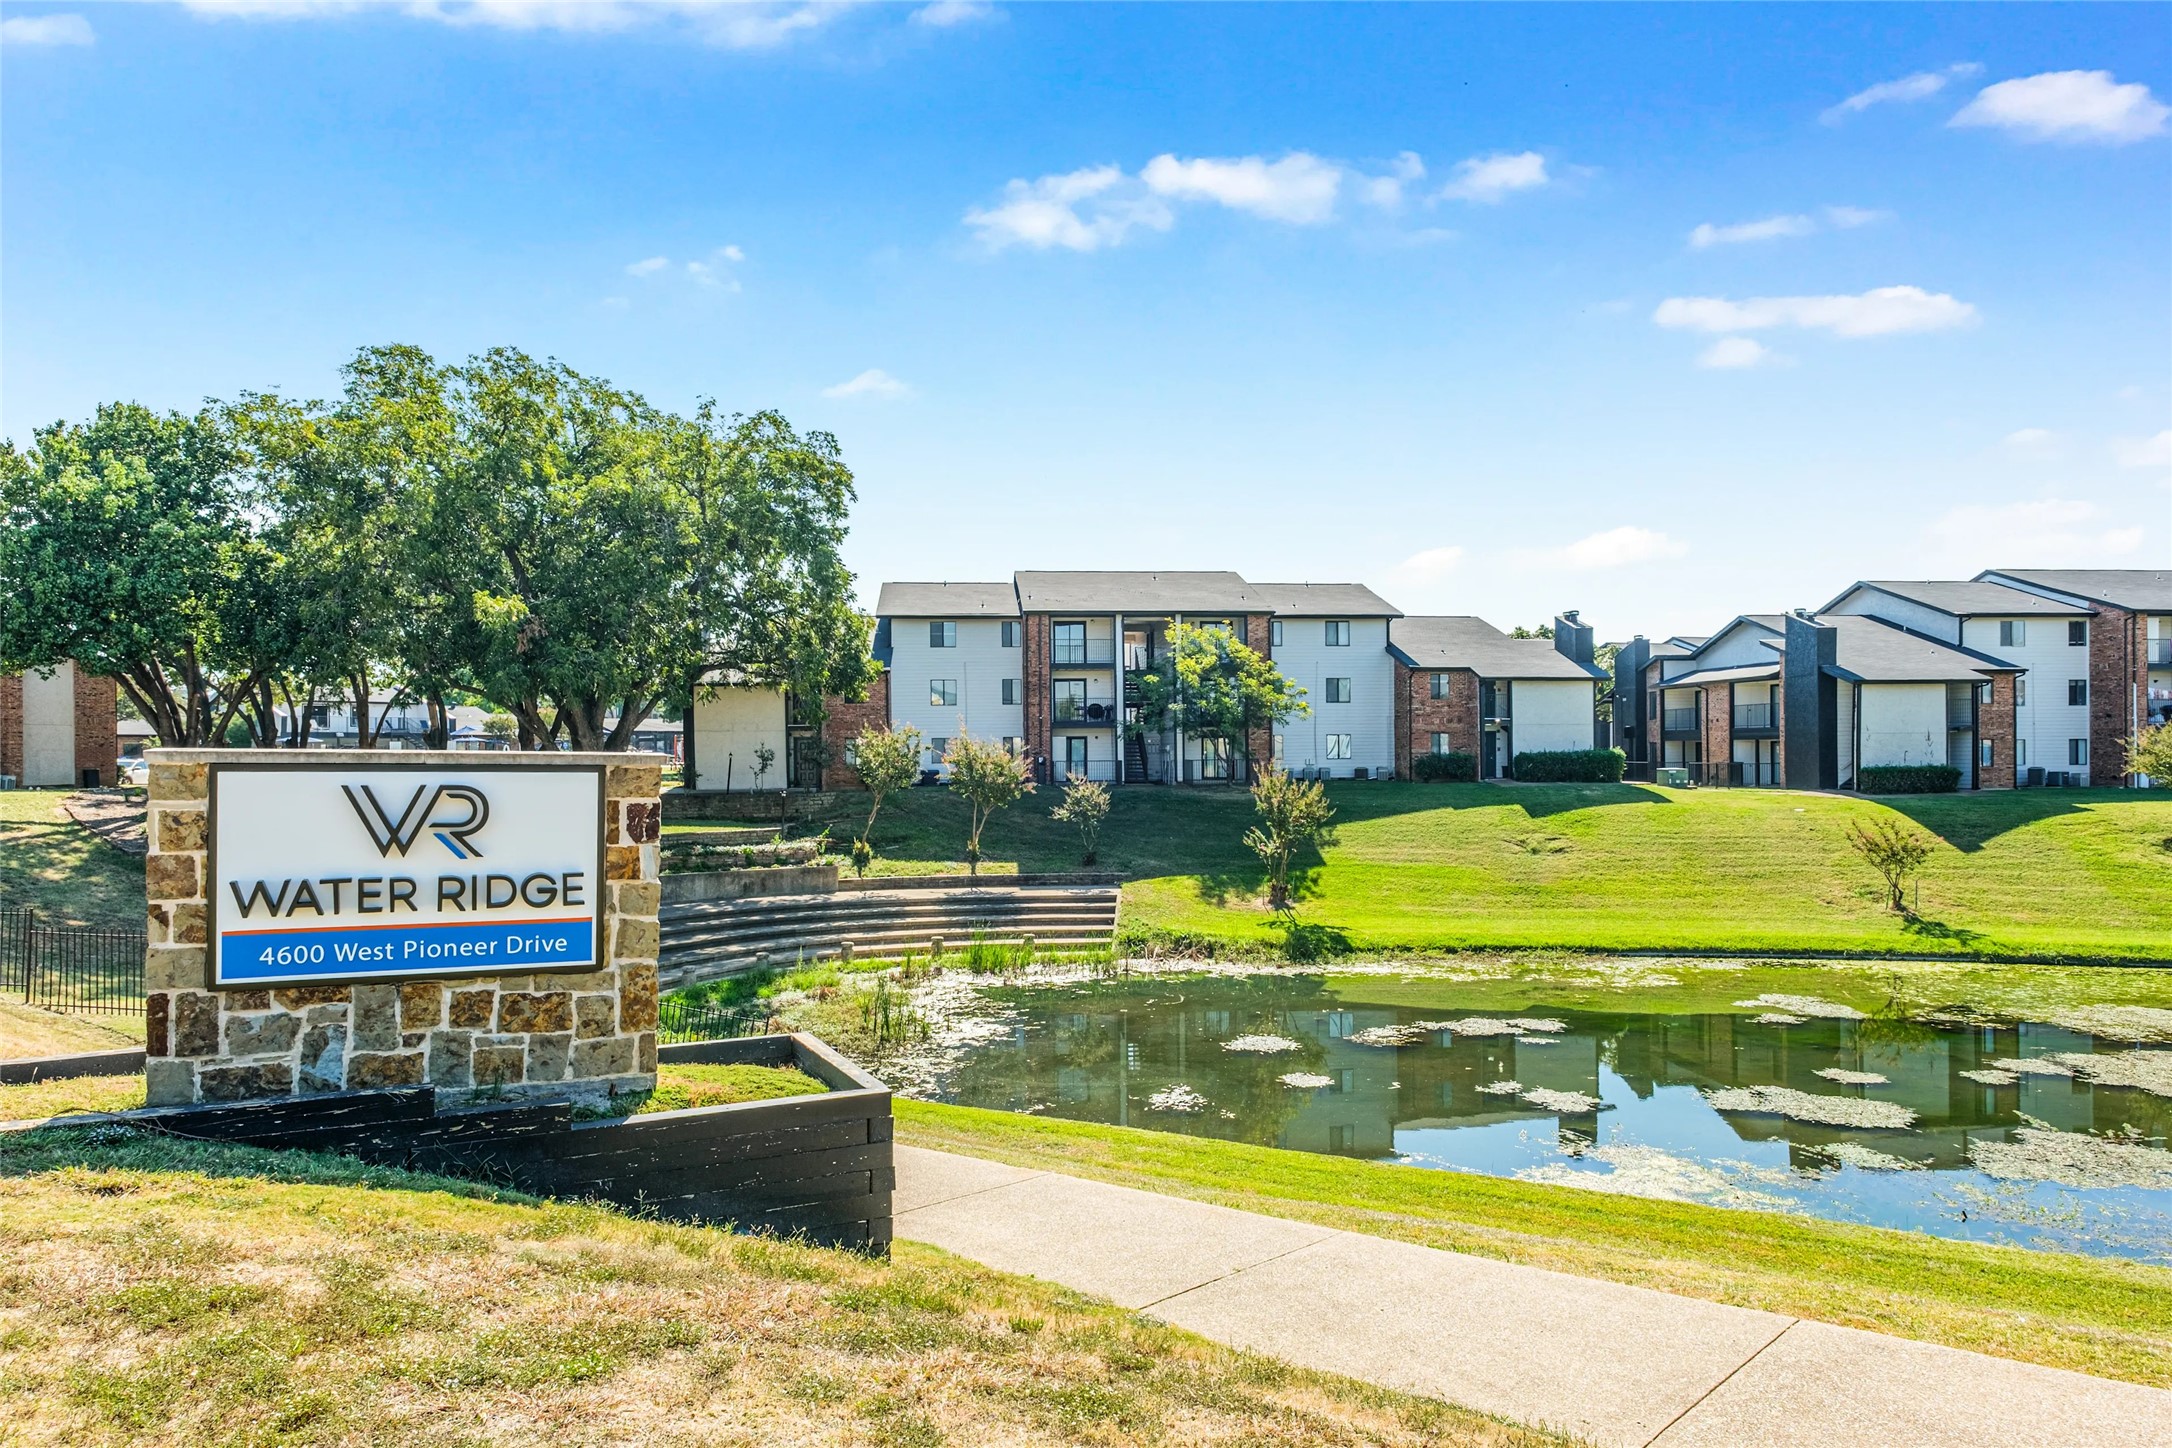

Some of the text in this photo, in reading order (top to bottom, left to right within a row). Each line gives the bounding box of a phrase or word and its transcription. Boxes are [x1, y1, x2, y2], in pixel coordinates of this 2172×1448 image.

[341, 784, 490, 859] WR
[229, 872, 585, 919] WATER RIDGE
[259, 934, 568, 966] 4600 West Pioneer Drive
